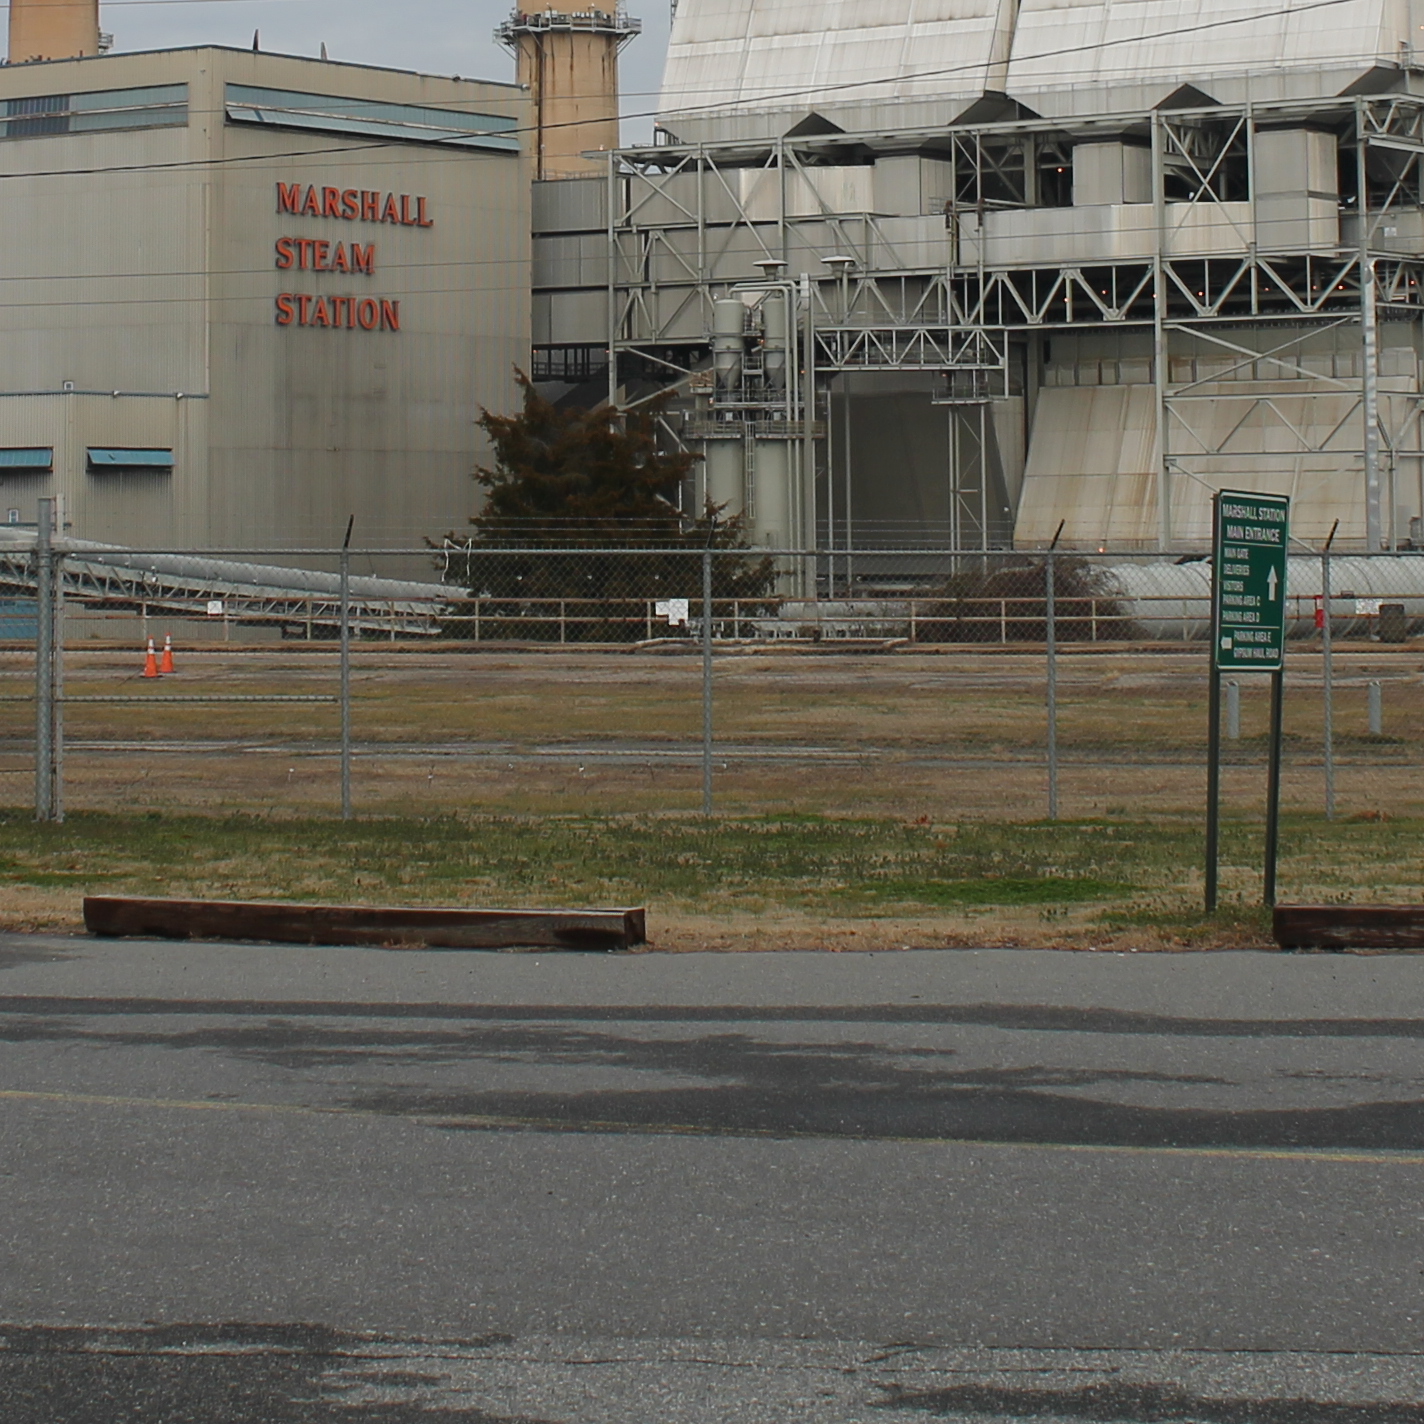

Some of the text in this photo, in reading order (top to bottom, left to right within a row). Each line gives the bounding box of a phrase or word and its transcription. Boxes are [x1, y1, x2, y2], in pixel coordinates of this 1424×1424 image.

[276, 182, 434, 227] MARSHALL
[276, 237, 375, 275] STEAM
[276, 292, 401, 331] STATION
[1222, 503, 1285, 522] MARSHALL STATION
[1227, 525, 1280, 542] MAIN ENTRANCE
[1224, 547, 1249, 560] MAIN GATE
[1223, 563, 1250, 576] DELIVERIES
[1223, 580, 1244, 592] VISITORS
[1223, 593, 1243, 606] PARKING
[1243, 595, 1256, 607] AREA
[1222, 610, 1243, 623] PARKING
[1243, 611, 1255, 623] AREA
[1234, 630, 1254, 642] PARKING
[1255, 631, 1267, 643] AREA
